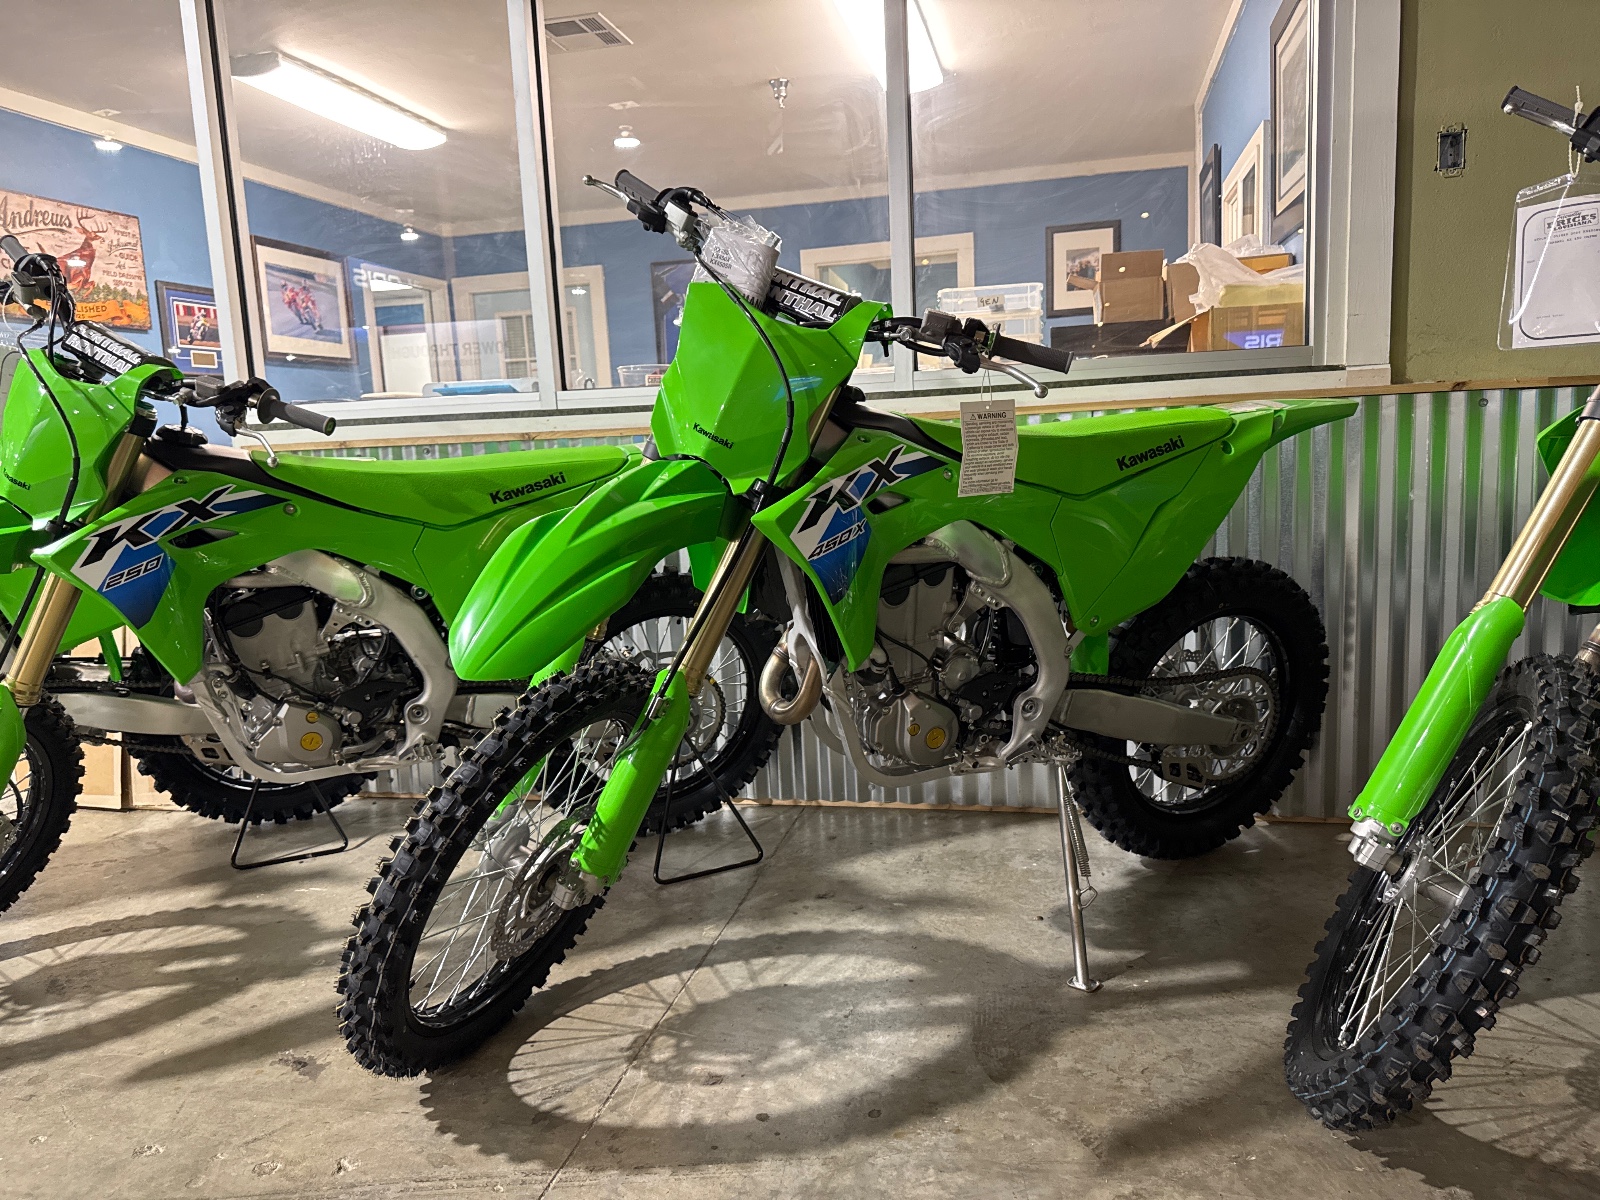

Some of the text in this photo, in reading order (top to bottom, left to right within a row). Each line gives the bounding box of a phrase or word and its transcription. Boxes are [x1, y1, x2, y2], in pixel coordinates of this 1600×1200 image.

[0, 195, 73, 228] Andrews
[768, 286, 836, 322] NTHAL
[771, 273, 842, 306] NTHAL
[977, 411, 1007, 420] WARNING
[693, 422, 735, 449] Kawasaki
[1116, 434, 1186, 471] Kawasaki
[489, 471, 567, 505] Kawasaki
[797, 446, 906, 534] KX
[79, 484, 236, 569] KX
[808, 520, 867, 560] 450X
[105, 555, 164, 591] 250
